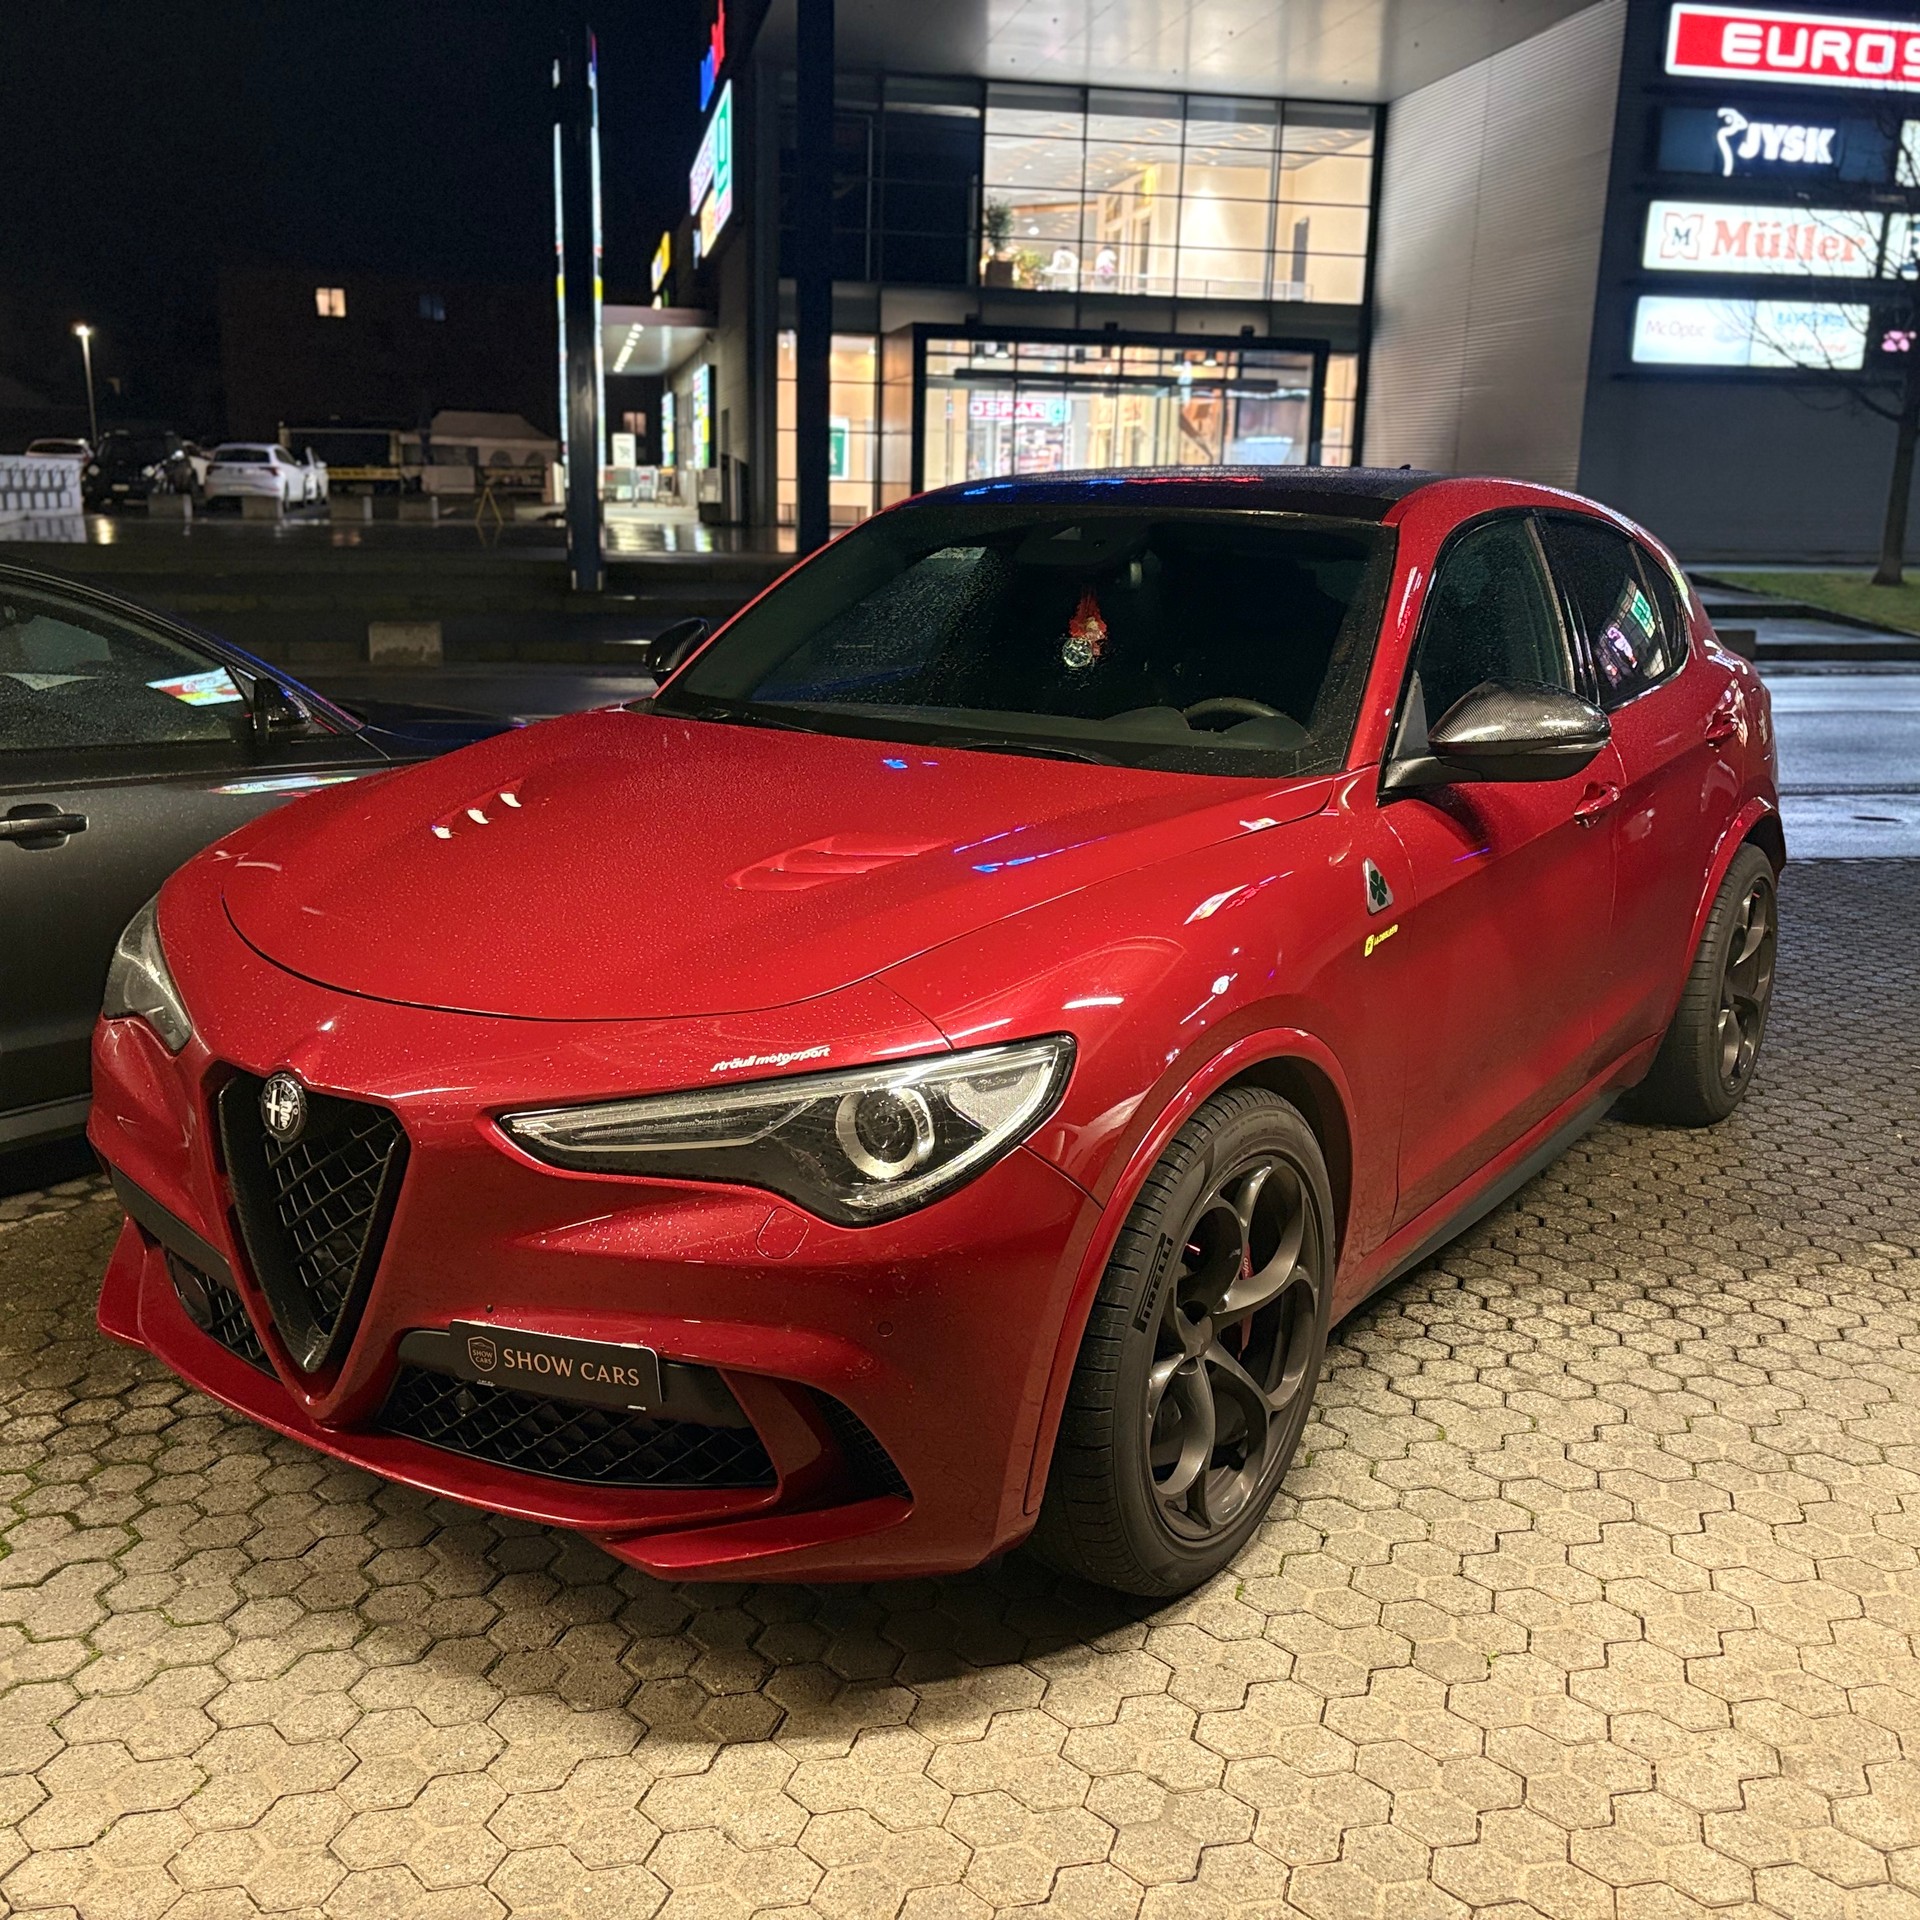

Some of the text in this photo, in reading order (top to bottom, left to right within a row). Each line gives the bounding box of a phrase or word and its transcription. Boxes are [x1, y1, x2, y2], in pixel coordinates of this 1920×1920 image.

[1737, 122, 1836, 164] JYSK
[1711, 219, 1866, 262] Müller
[1132, 1232, 1174, 1333] PIRELLI
[472, 1349, 493, 1359] SHOW
[475, 1356, 492, 1366] CARS
[503, 1348, 640, 1387] SHOW CARS
